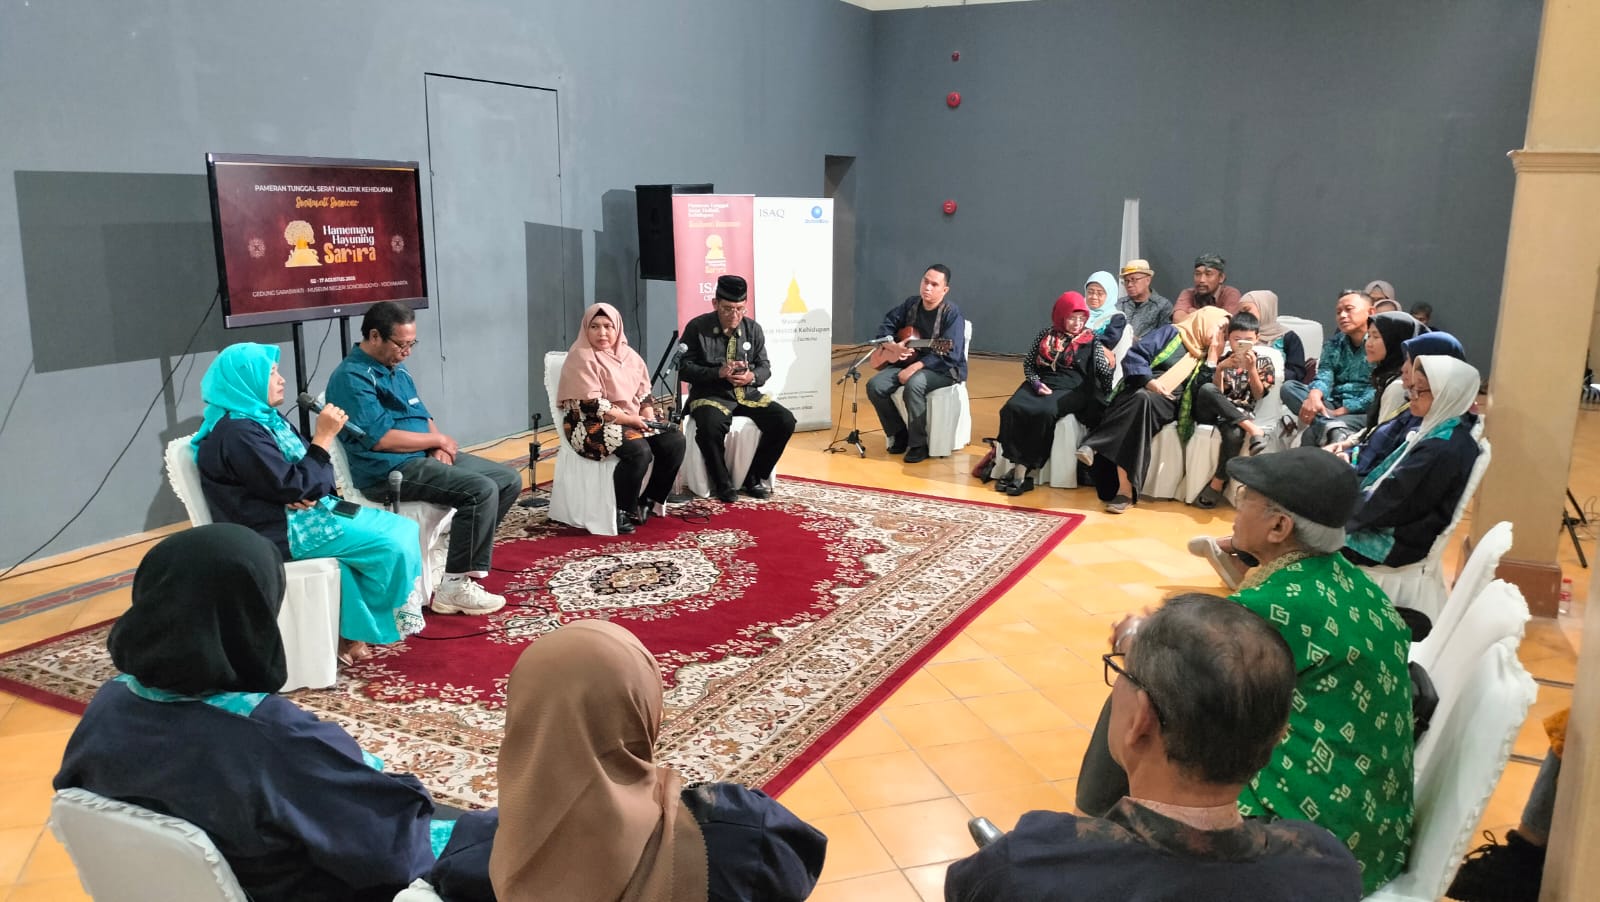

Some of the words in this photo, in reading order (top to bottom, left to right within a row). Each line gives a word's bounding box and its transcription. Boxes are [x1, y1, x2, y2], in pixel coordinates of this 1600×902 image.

[254, 184, 286, 192] PAMERAN
[316, 185, 335, 193] SERAT
[759, 208, 785, 219] ISAQ
[323, 225, 374, 235] Hamemayu
[332, 234, 375, 246] Hayuning
[323, 242, 377, 264] Sarira
[698, 282, 718, 294] ISA
